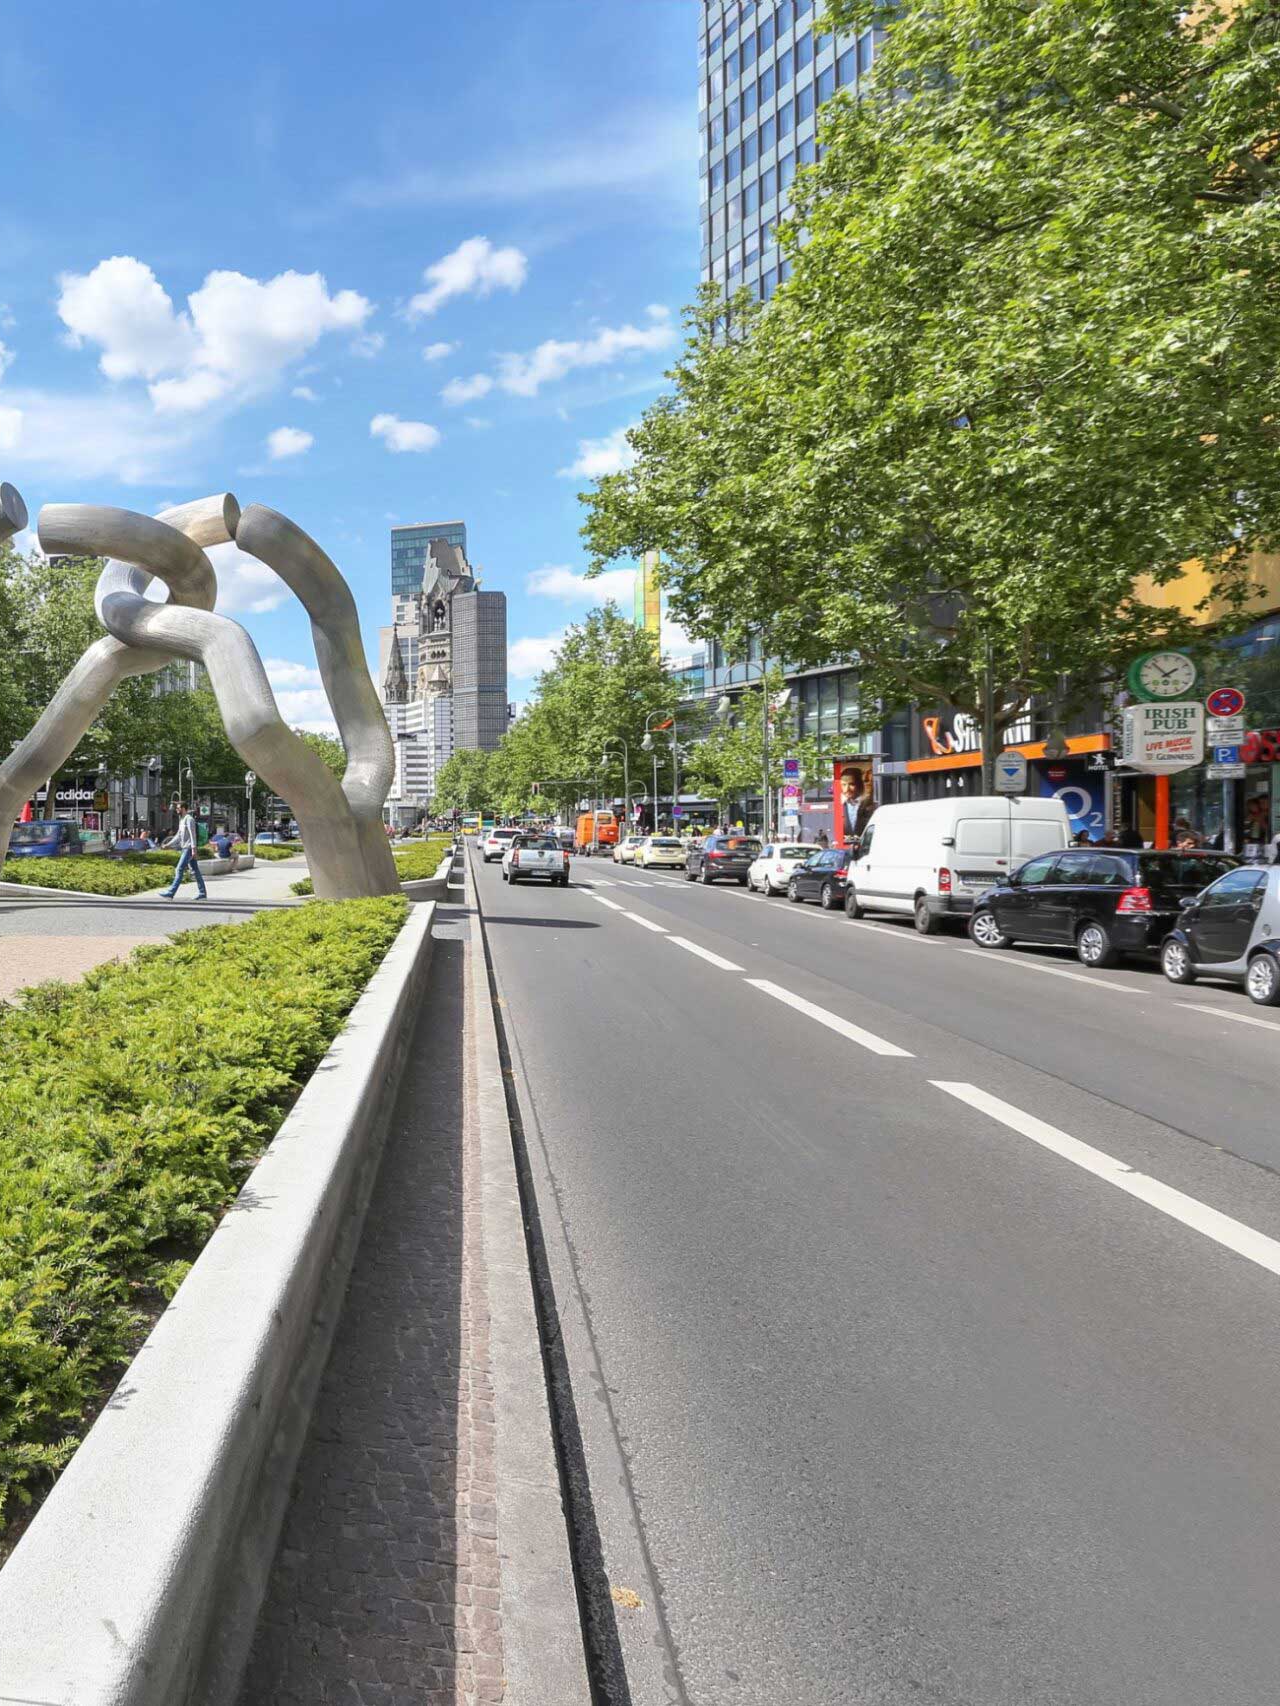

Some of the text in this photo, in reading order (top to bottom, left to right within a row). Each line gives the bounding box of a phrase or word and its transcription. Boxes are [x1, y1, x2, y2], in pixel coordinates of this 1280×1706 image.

[1144, 707, 1196, 719] IRISH
[1152, 719, 1189, 730] PUB
[1145, 741, 1163, 751] LIVE
[1156, 753, 1195, 761] GUINNESS
[1218, 748, 1232, 762] P
